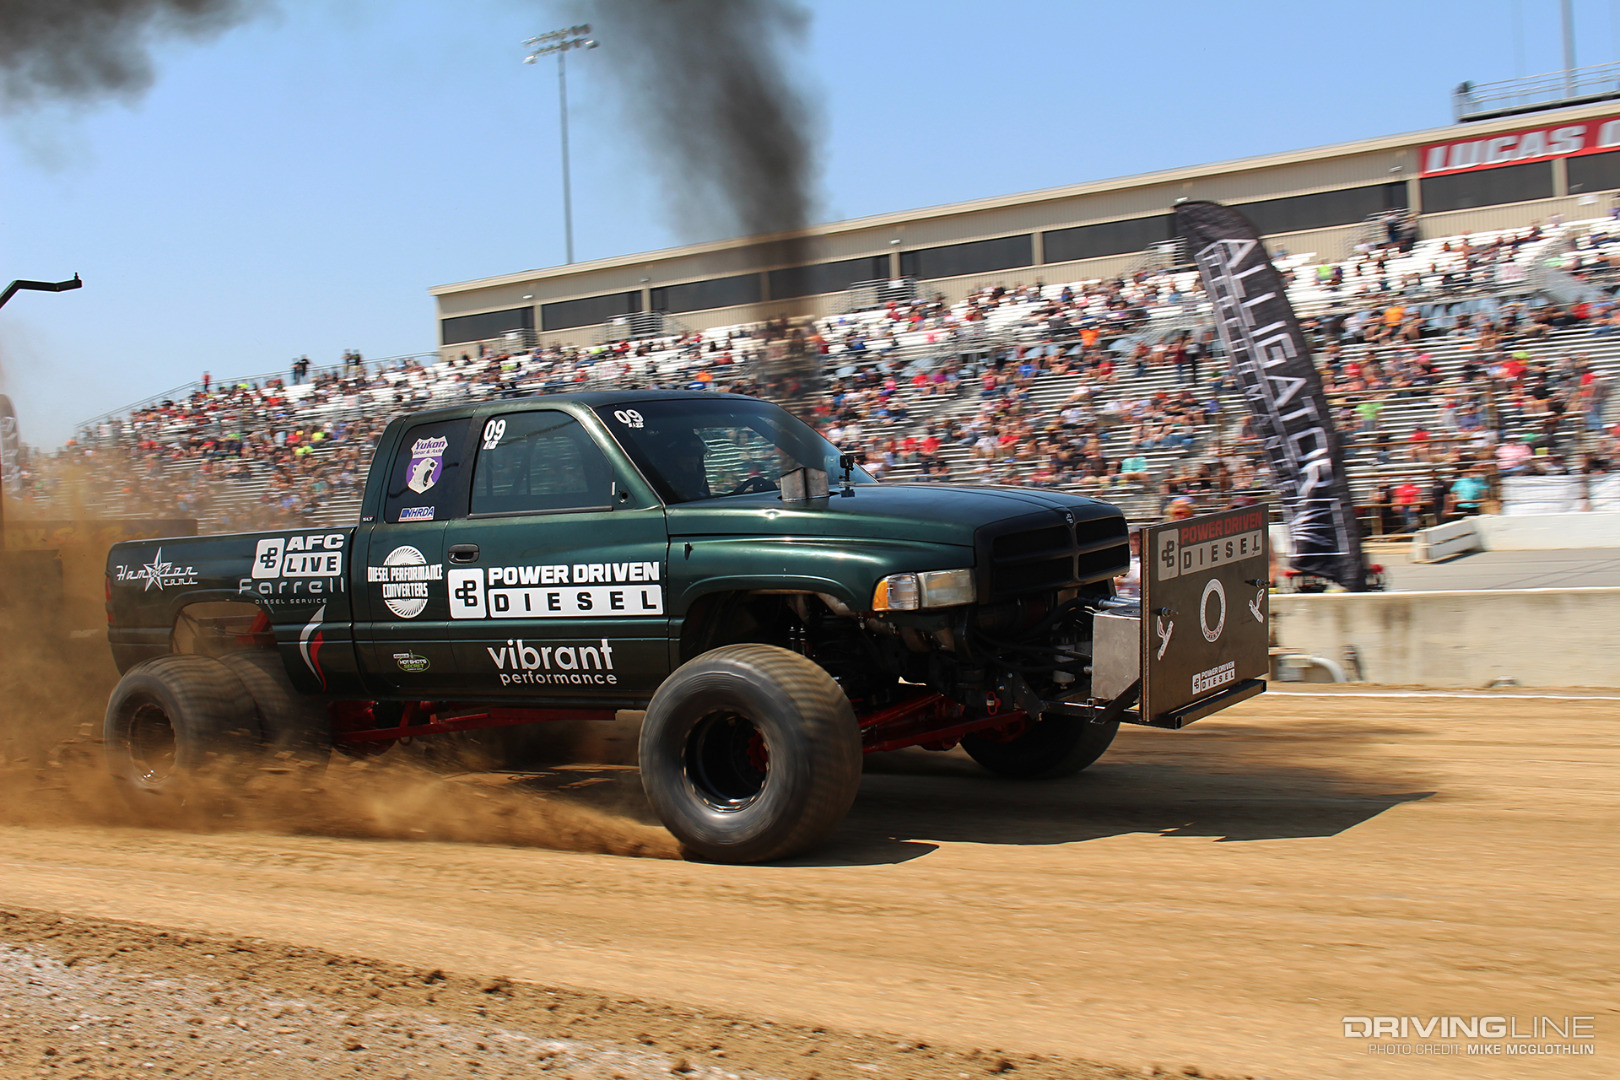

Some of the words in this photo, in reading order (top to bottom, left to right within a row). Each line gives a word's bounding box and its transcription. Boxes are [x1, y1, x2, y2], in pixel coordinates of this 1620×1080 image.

[1425, 125, 1587, 174] LUCAS
[1217, 238, 1333, 498] ALLIGATOR
[613, 409, 644, 424] 09
[483, 419, 506, 441] 09
[415, 440, 446, 450] Yukon
[1181, 521, 1223, 545] POWER
[1225, 511, 1263, 537] DRIVEN
[286, 534, 345, 551] AFC
[1183, 534, 1260, 570] DIESEL
[286, 556, 338, 573] LIVE
[367, 566, 390, 583] DIESEL
[391, 563, 443, 582] PERFORMANCE
[488, 564, 569, 586] POWER
[573, 562, 660, 583] DRIVEN
[238, 577, 345, 595] Farrell
[382, 582, 429, 599] CONVERTERS
[494, 590, 657, 612] DIESEL
[486, 639, 614, 671] vibrant
[500, 670, 618, 687] performance
[1201, 670, 1234, 689] DIESEL
